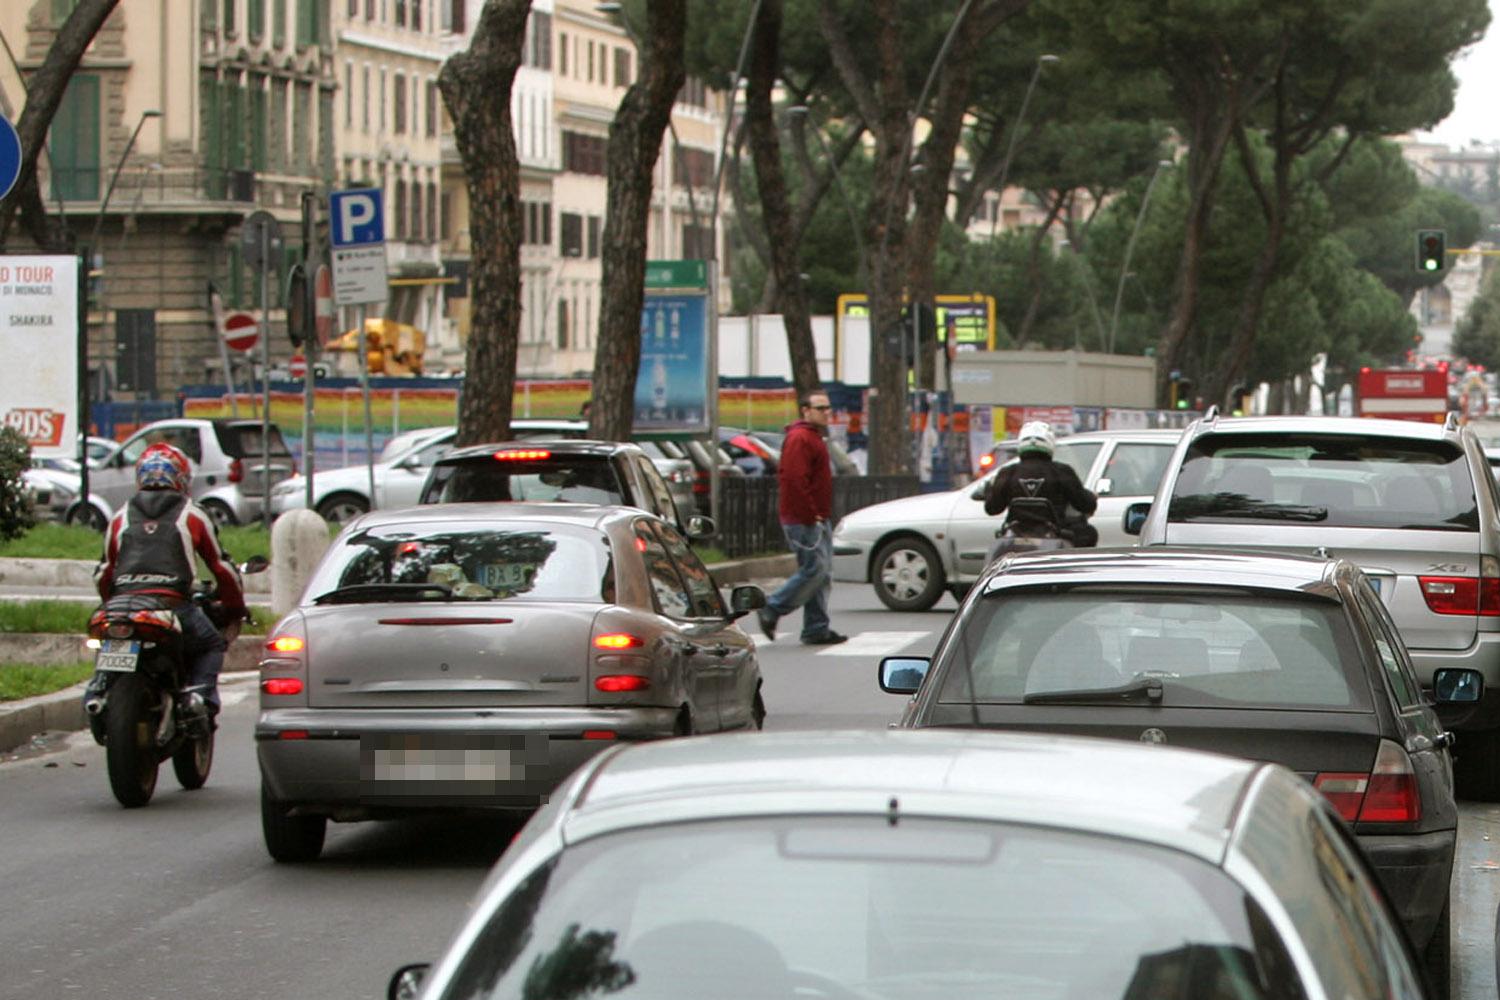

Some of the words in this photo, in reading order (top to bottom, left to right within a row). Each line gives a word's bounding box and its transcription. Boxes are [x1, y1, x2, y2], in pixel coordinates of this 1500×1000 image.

[340, 194, 375, 242] P
[16, 266, 54, 283] TOUR
[9, 315, 54, 327] SHAKIRA
